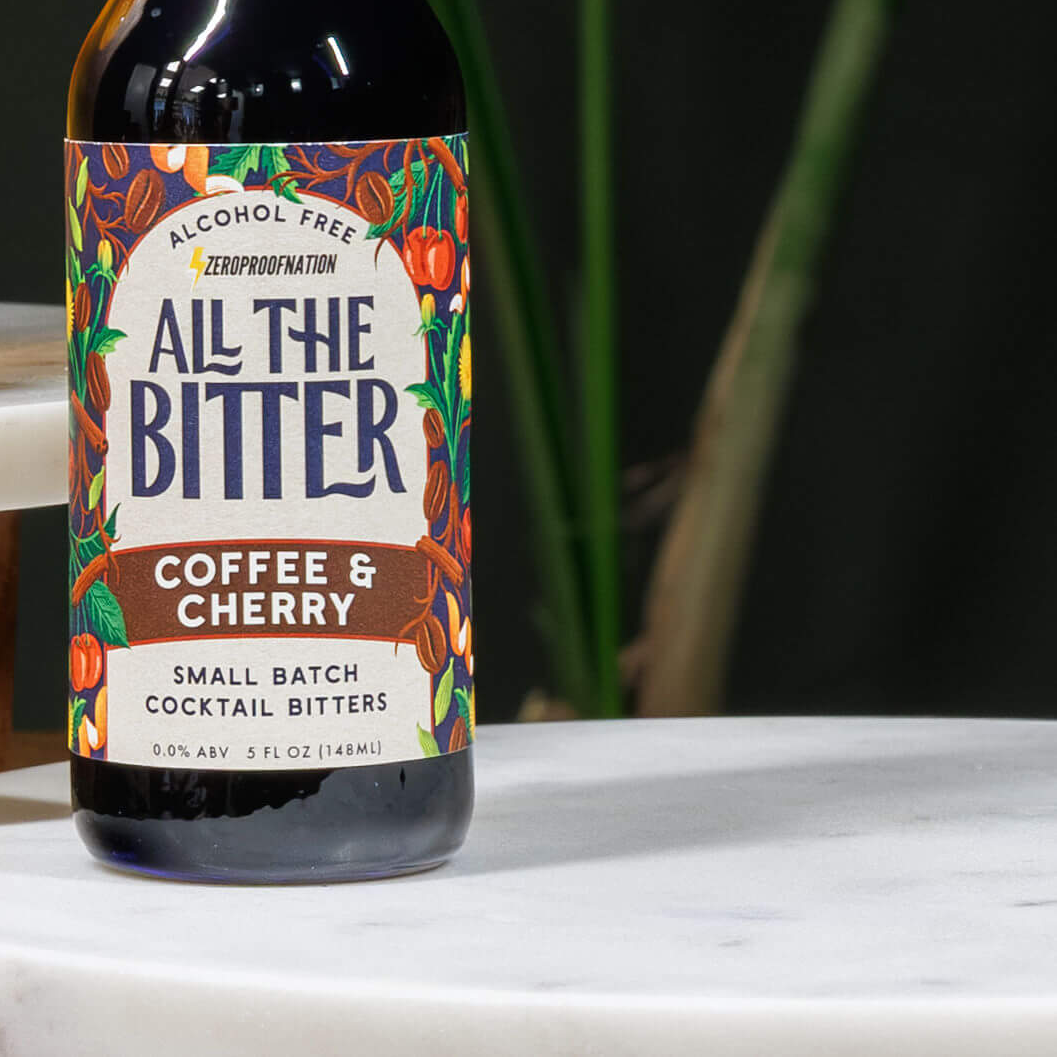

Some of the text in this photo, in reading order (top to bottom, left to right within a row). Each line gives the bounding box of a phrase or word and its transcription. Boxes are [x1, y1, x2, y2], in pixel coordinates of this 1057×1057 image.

[168, 203, 358, 250] ALCOHOL FREE
[203, 252, 338, 277] ZEROPROOFNATION
[148, 295, 375, 377] ALL THE
[129, 378, 409, 501] BITTER
[154, 550, 377, 590] COFFEE &
[177, 591, 356, 628] CHERRY
[173, 663, 358, 686] SMALL BATCH
[145, 692, 387, 717] COCKTAIL BITTERS
[153, 740, 383, 761] 0.0% ABV 5 FL OZ (148ML)
